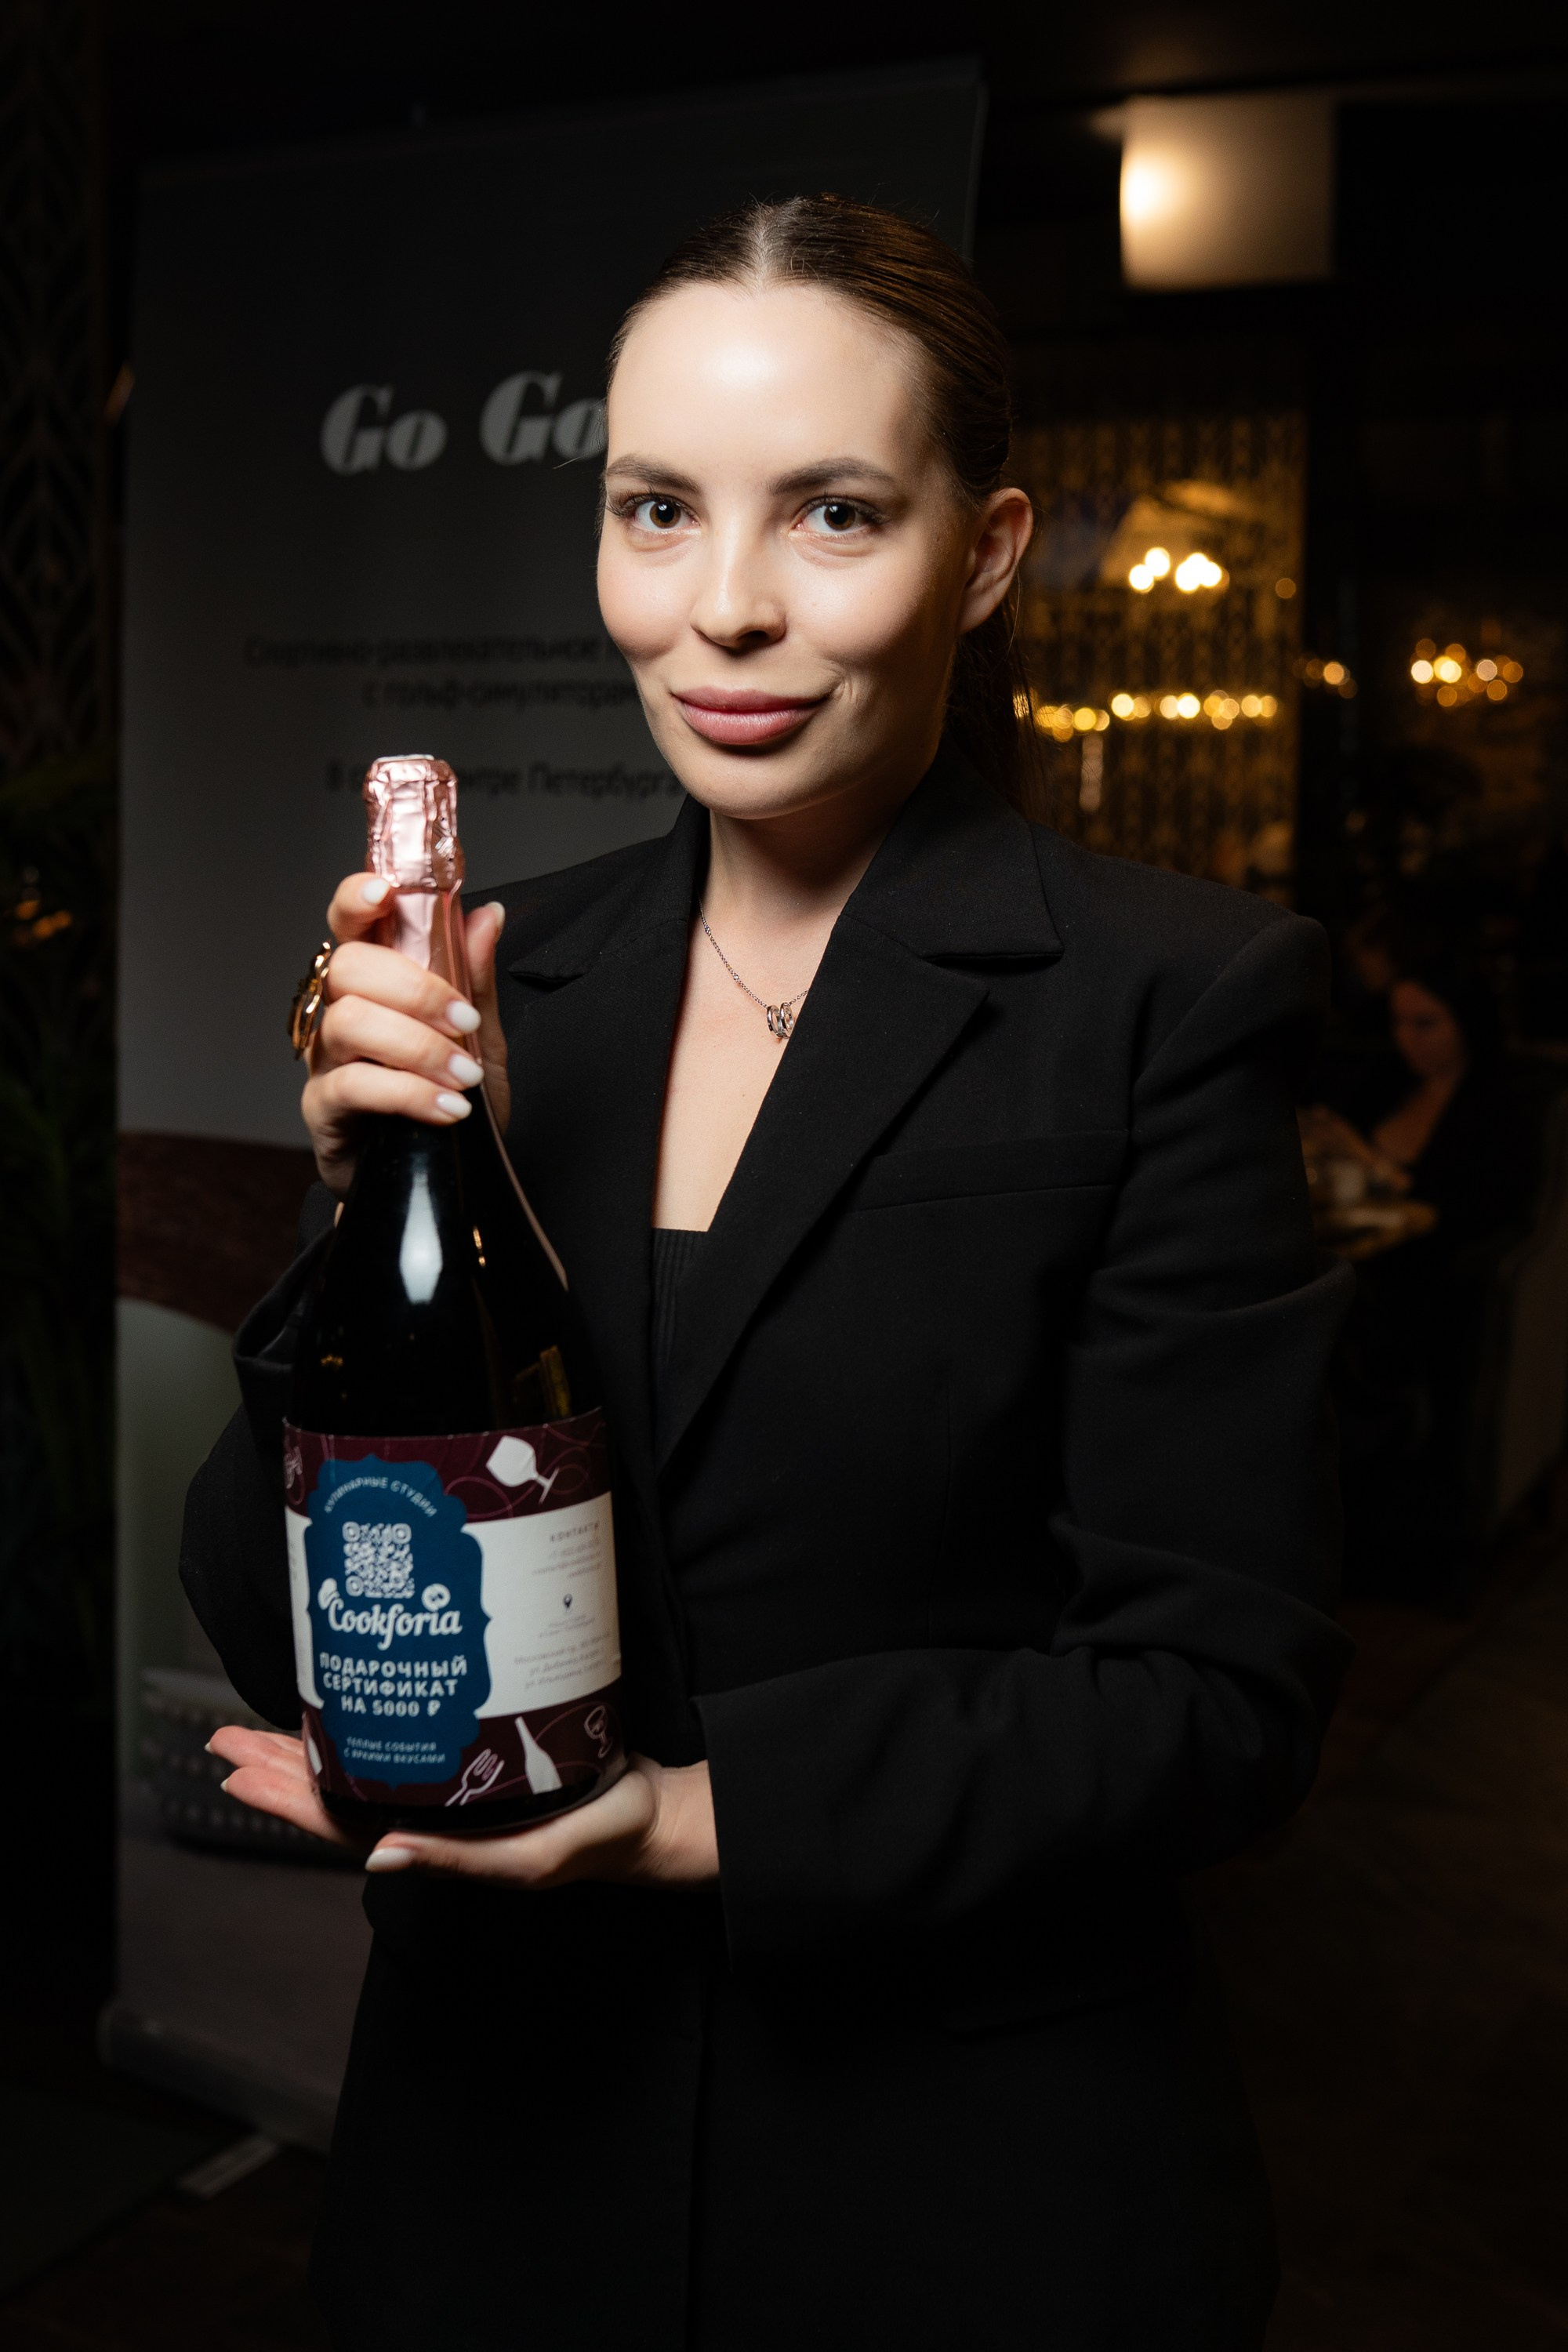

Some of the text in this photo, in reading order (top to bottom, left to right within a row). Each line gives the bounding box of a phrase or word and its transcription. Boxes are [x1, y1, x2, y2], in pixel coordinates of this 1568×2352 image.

[320, 370, 608, 477] Go Go
[390, 1479, 437, 1517] СТУДИИ
[328, 1597, 463, 1651] Cookforia
[319, 1651, 468, 1679] ПОДАРОЧНЫЙ
[322, 1671, 458, 1697] СЕРТИФИКАТ
[340, 1694, 367, 1714] НА
[372, 1699, 421, 1718] 5000
[384, 1740, 437, 1753] СОБЫТИЯ
